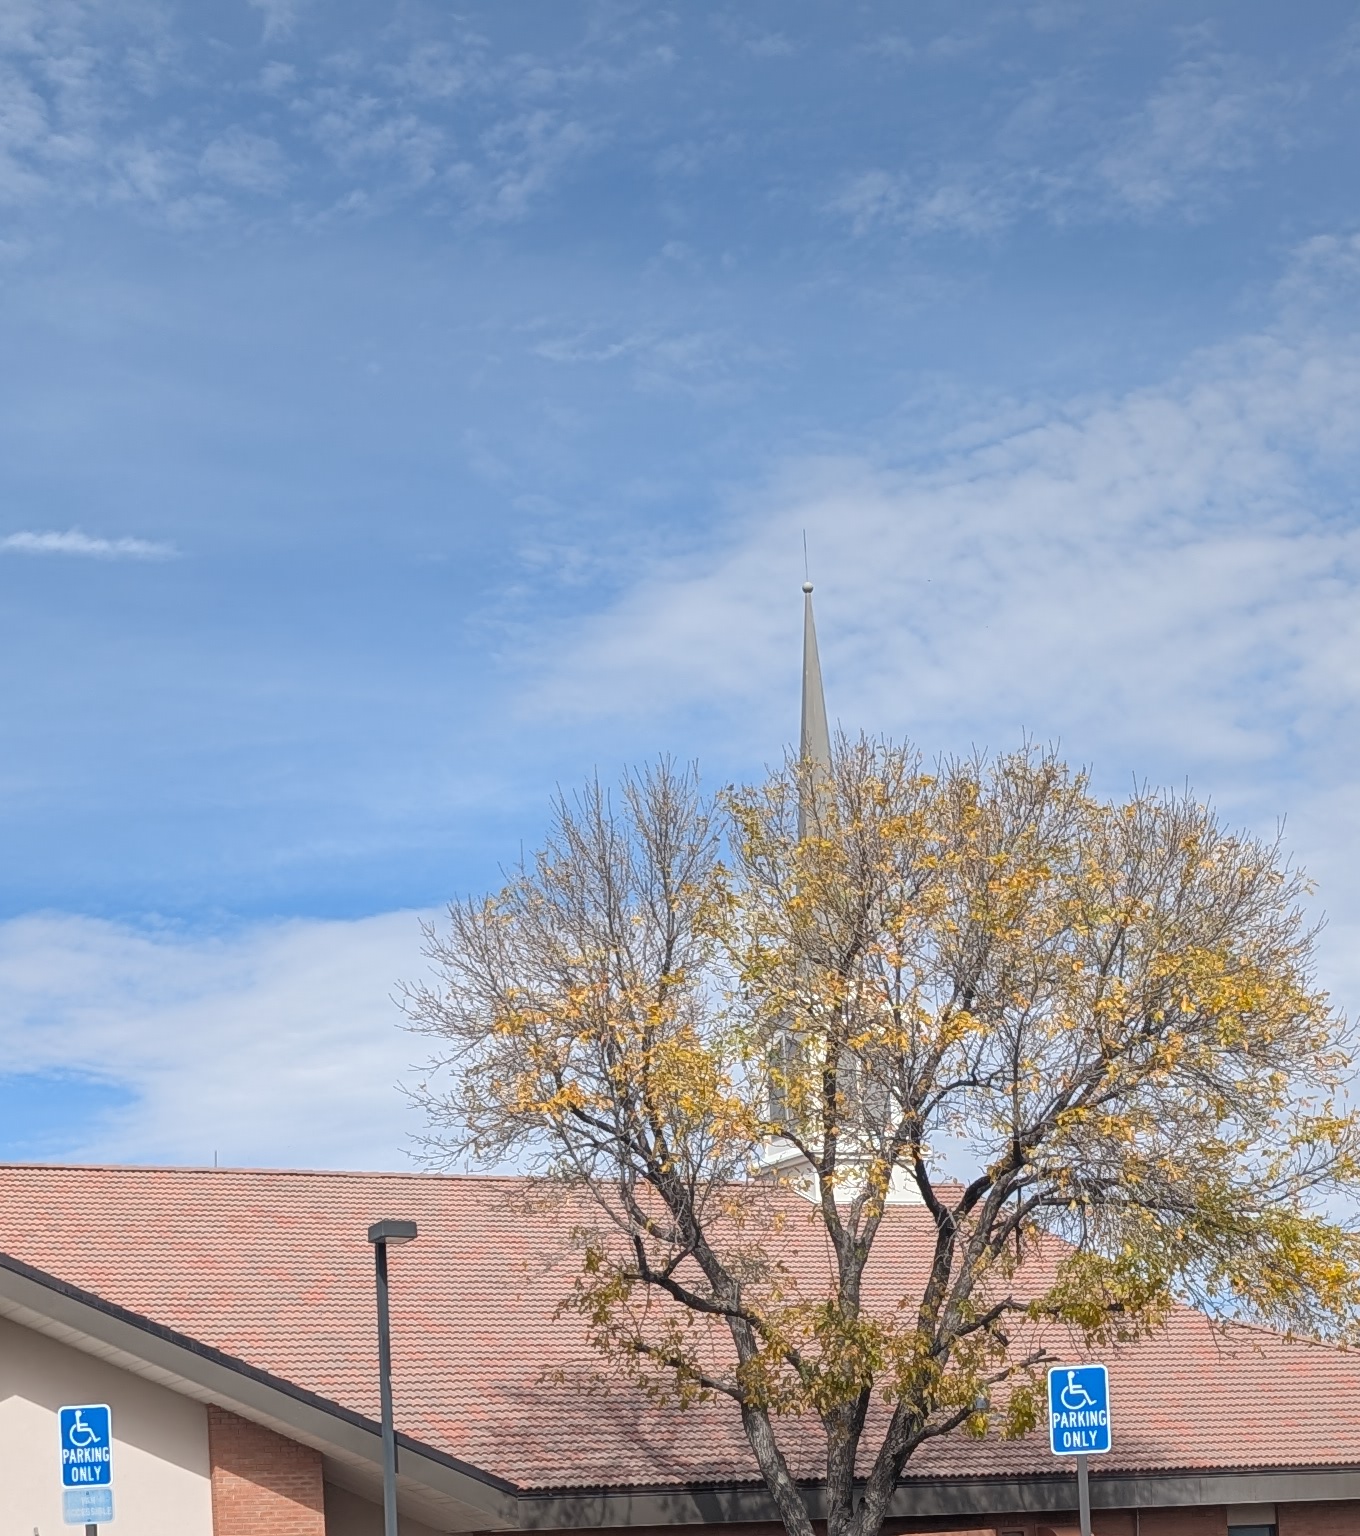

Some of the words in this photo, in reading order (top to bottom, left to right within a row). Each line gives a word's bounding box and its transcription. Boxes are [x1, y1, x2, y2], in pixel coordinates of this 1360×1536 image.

[1053, 1409, 1107, 1428] PARKING
[1063, 1430, 1098, 1448] ONLY
[62, 1447, 110, 1464] PARKING
[71, 1466, 102, 1482] ONLY
